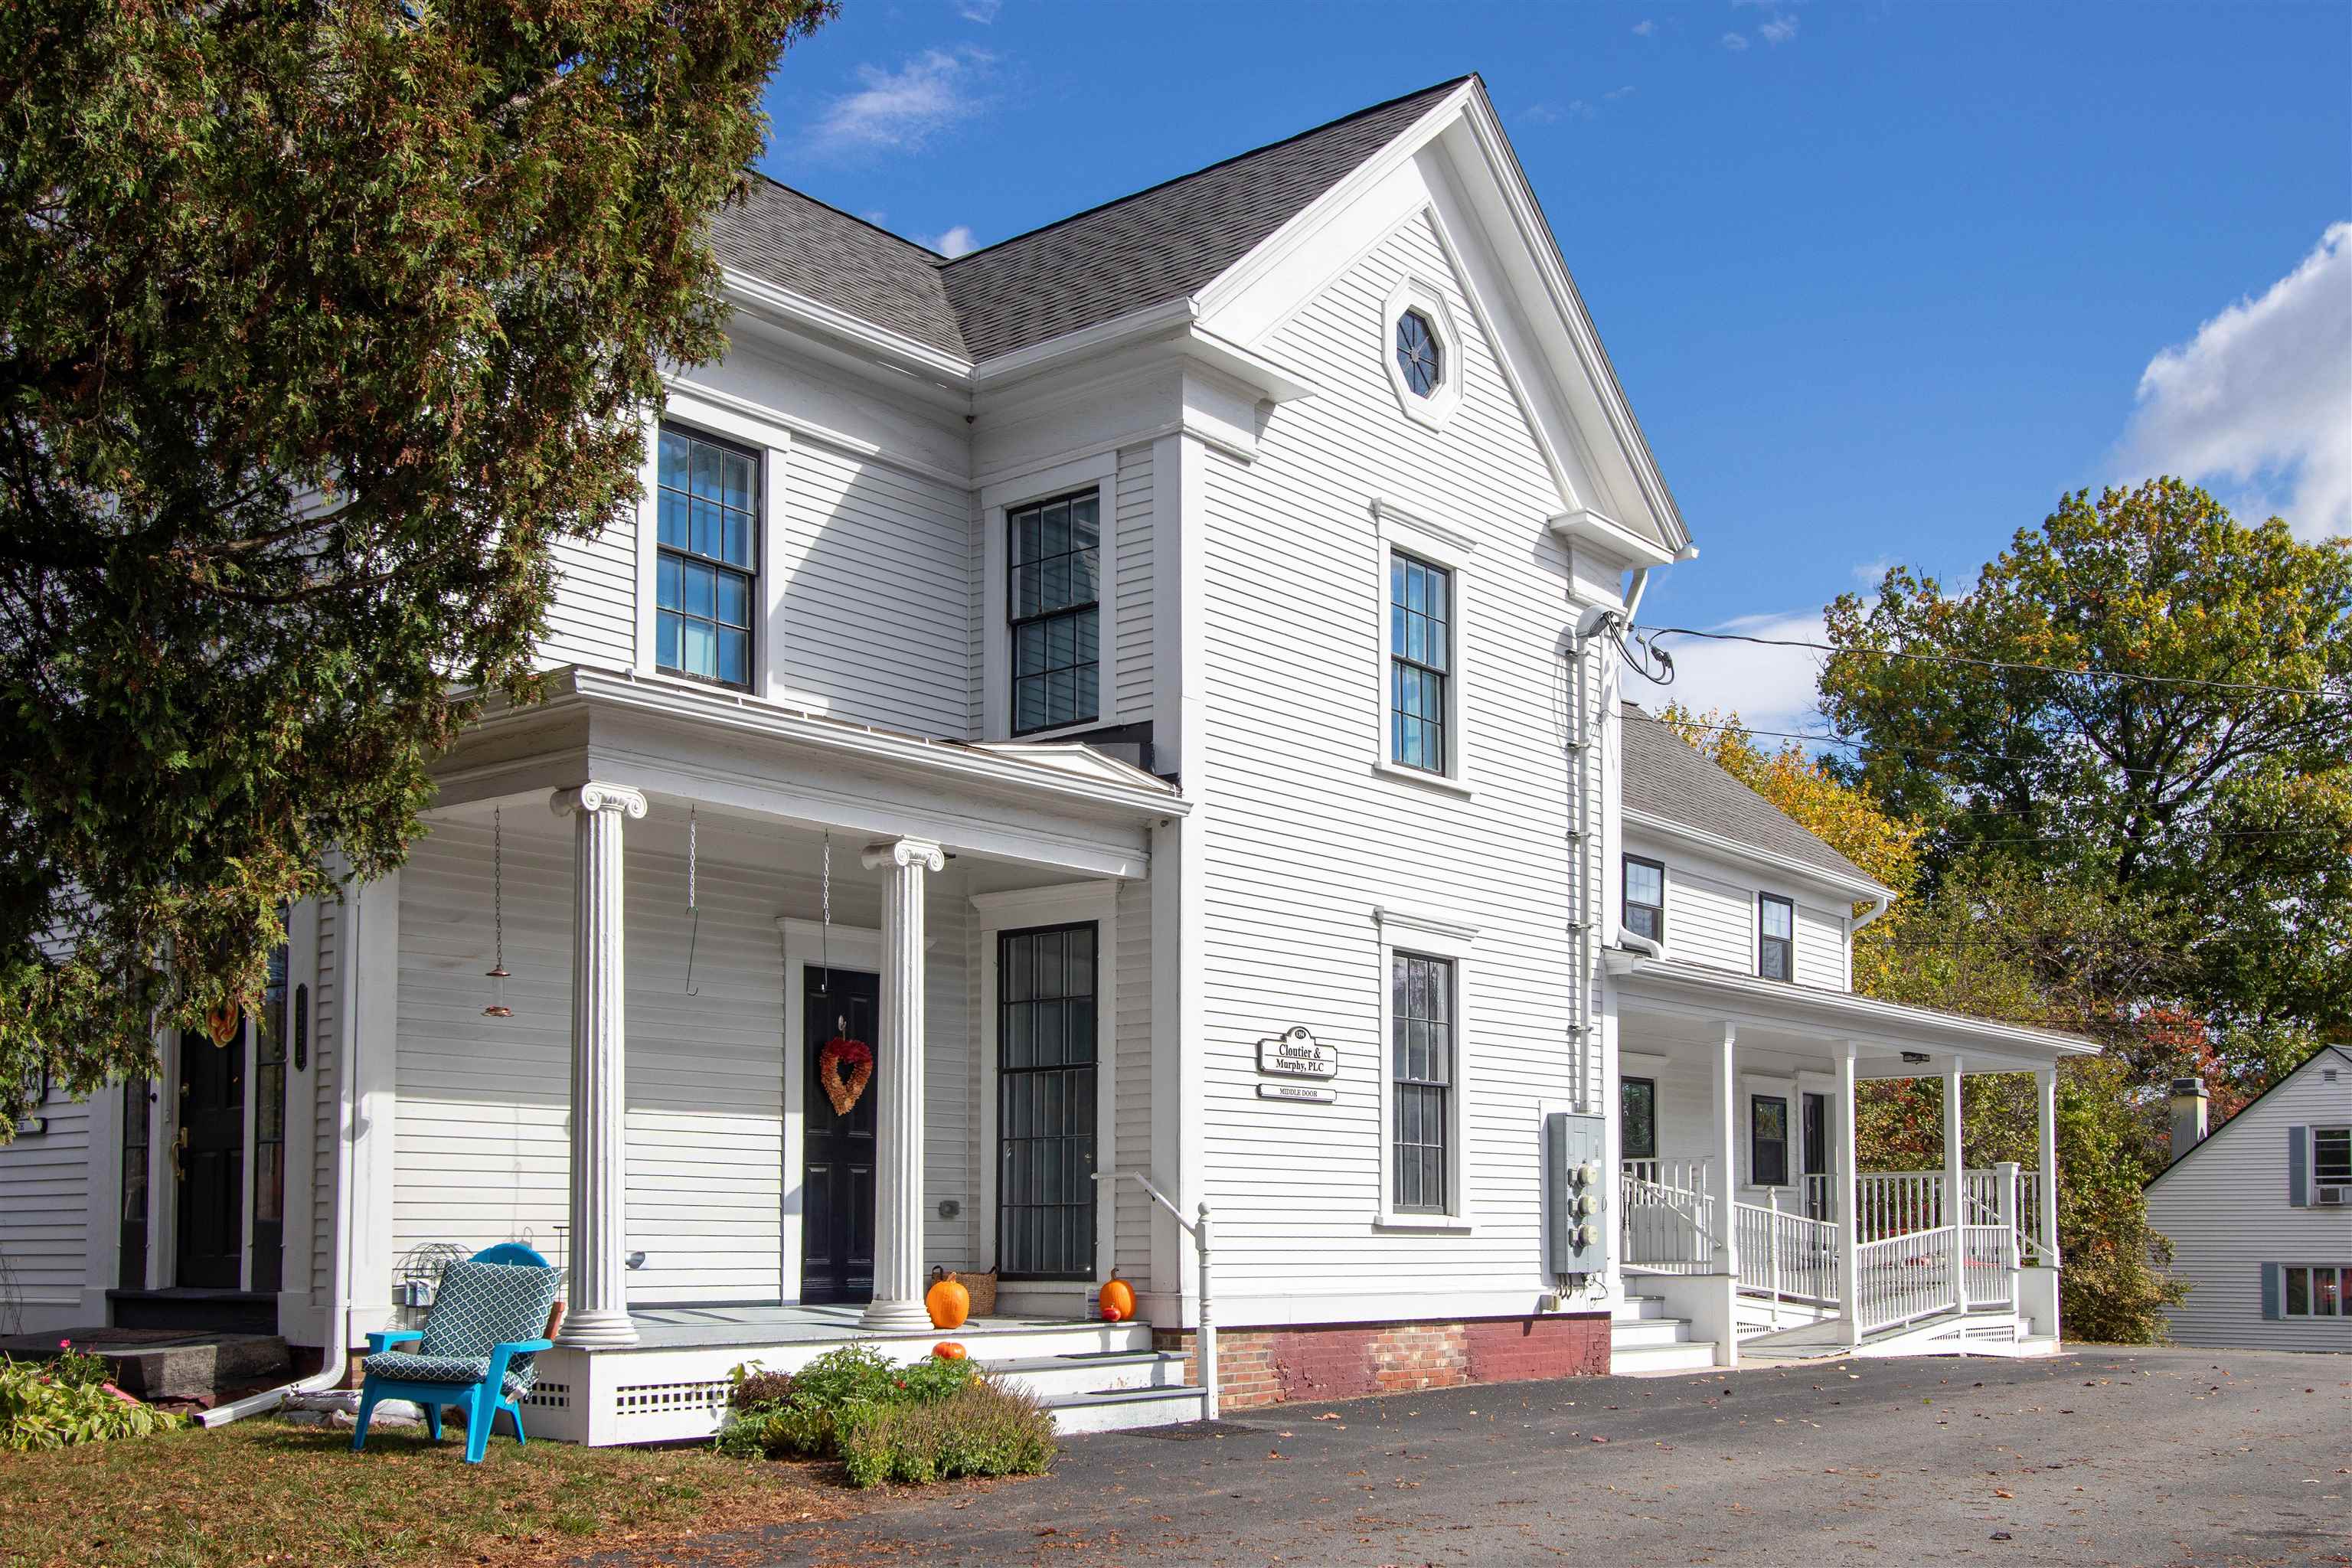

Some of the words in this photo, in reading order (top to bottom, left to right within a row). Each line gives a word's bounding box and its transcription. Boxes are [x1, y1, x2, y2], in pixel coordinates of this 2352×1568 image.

[1279, 1044, 1312, 1058] Cloutier
[1314, 1047, 1321, 1059] &
[1276, 1058, 1306, 1072] Murphy,
[1308, 1062, 1324, 1072] PLC
[1279, 1087, 1301, 1096] MIDDLE
